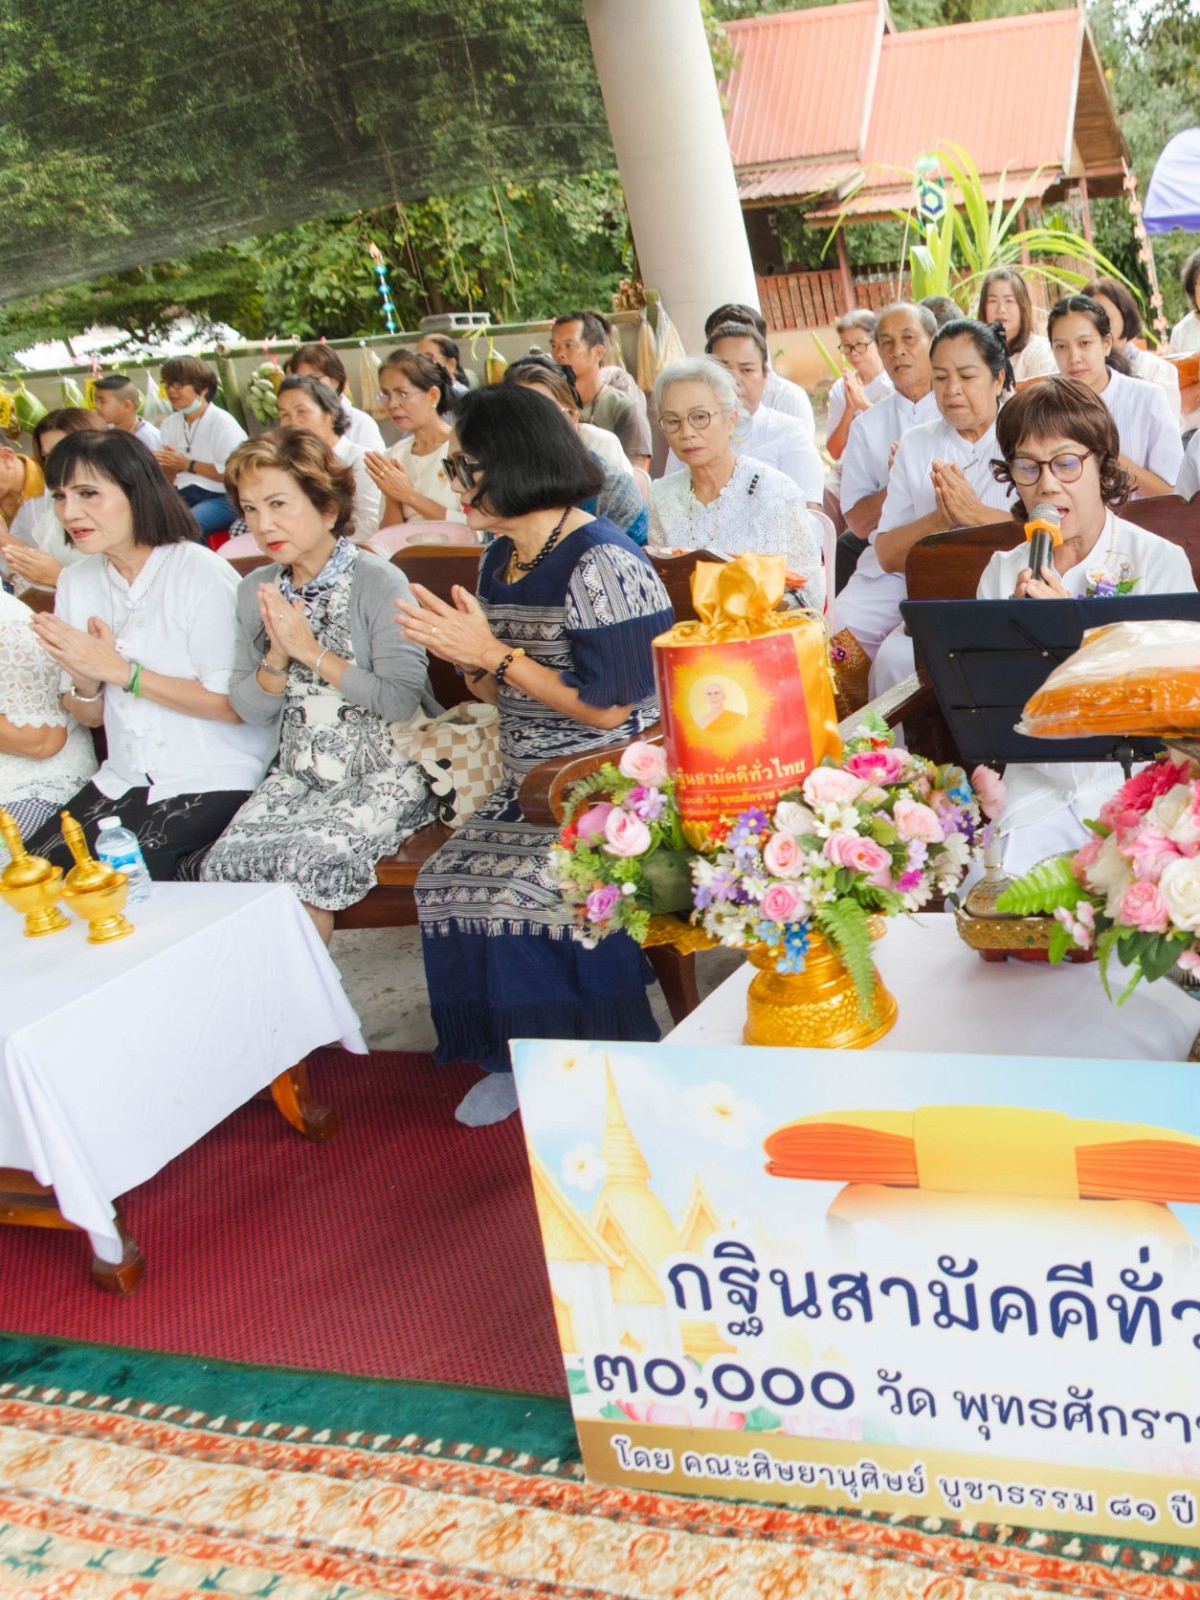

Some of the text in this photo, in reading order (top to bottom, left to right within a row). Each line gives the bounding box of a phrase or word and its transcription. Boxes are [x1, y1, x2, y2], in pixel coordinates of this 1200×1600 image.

[593, 1353, 856, 1410] ๓๐,๐๐๐
[876, 1368, 937, 1418] วัด
[614, 1438, 672, 1471] โดย
[684, 1452, 925, 1499] คณะศิษยานุศิษย์
[939, 1477, 1094, 1513] บูชาธรรม
[1109, 1497, 1157, 1521] ๘๑
[1172, 1493, 1195, 1524] ปี
